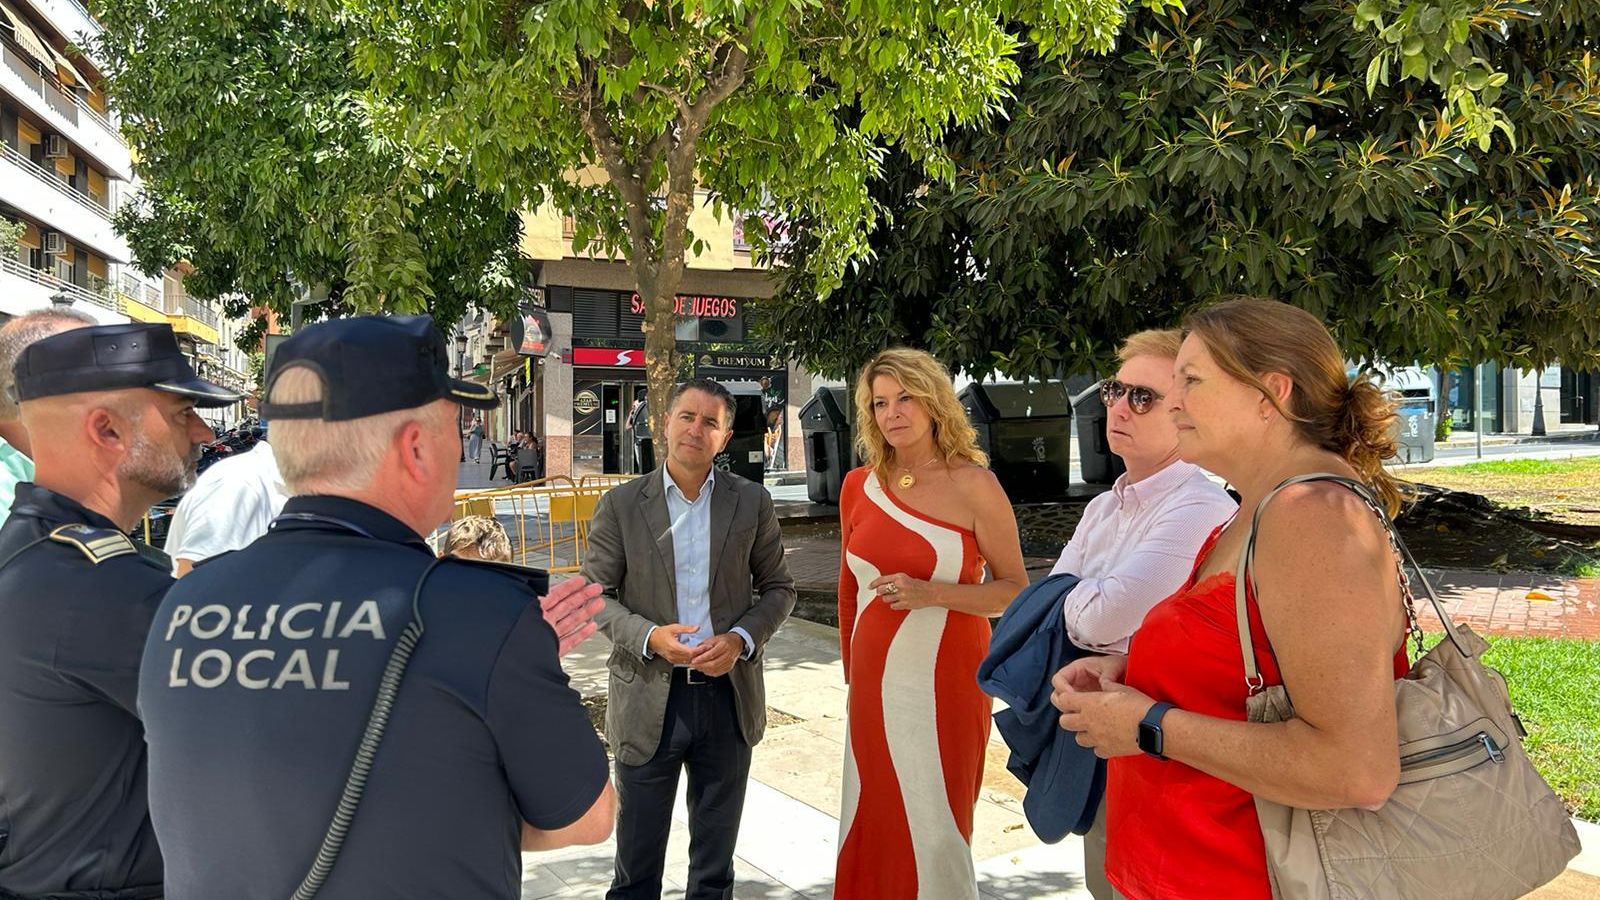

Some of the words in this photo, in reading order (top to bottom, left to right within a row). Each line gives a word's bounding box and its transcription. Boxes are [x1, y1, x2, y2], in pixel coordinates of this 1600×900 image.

[690, 297, 737, 317] JUEGOS
[165, 600, 386, 641] POLICIA
[168, 648, 350, 690] LOCAL
